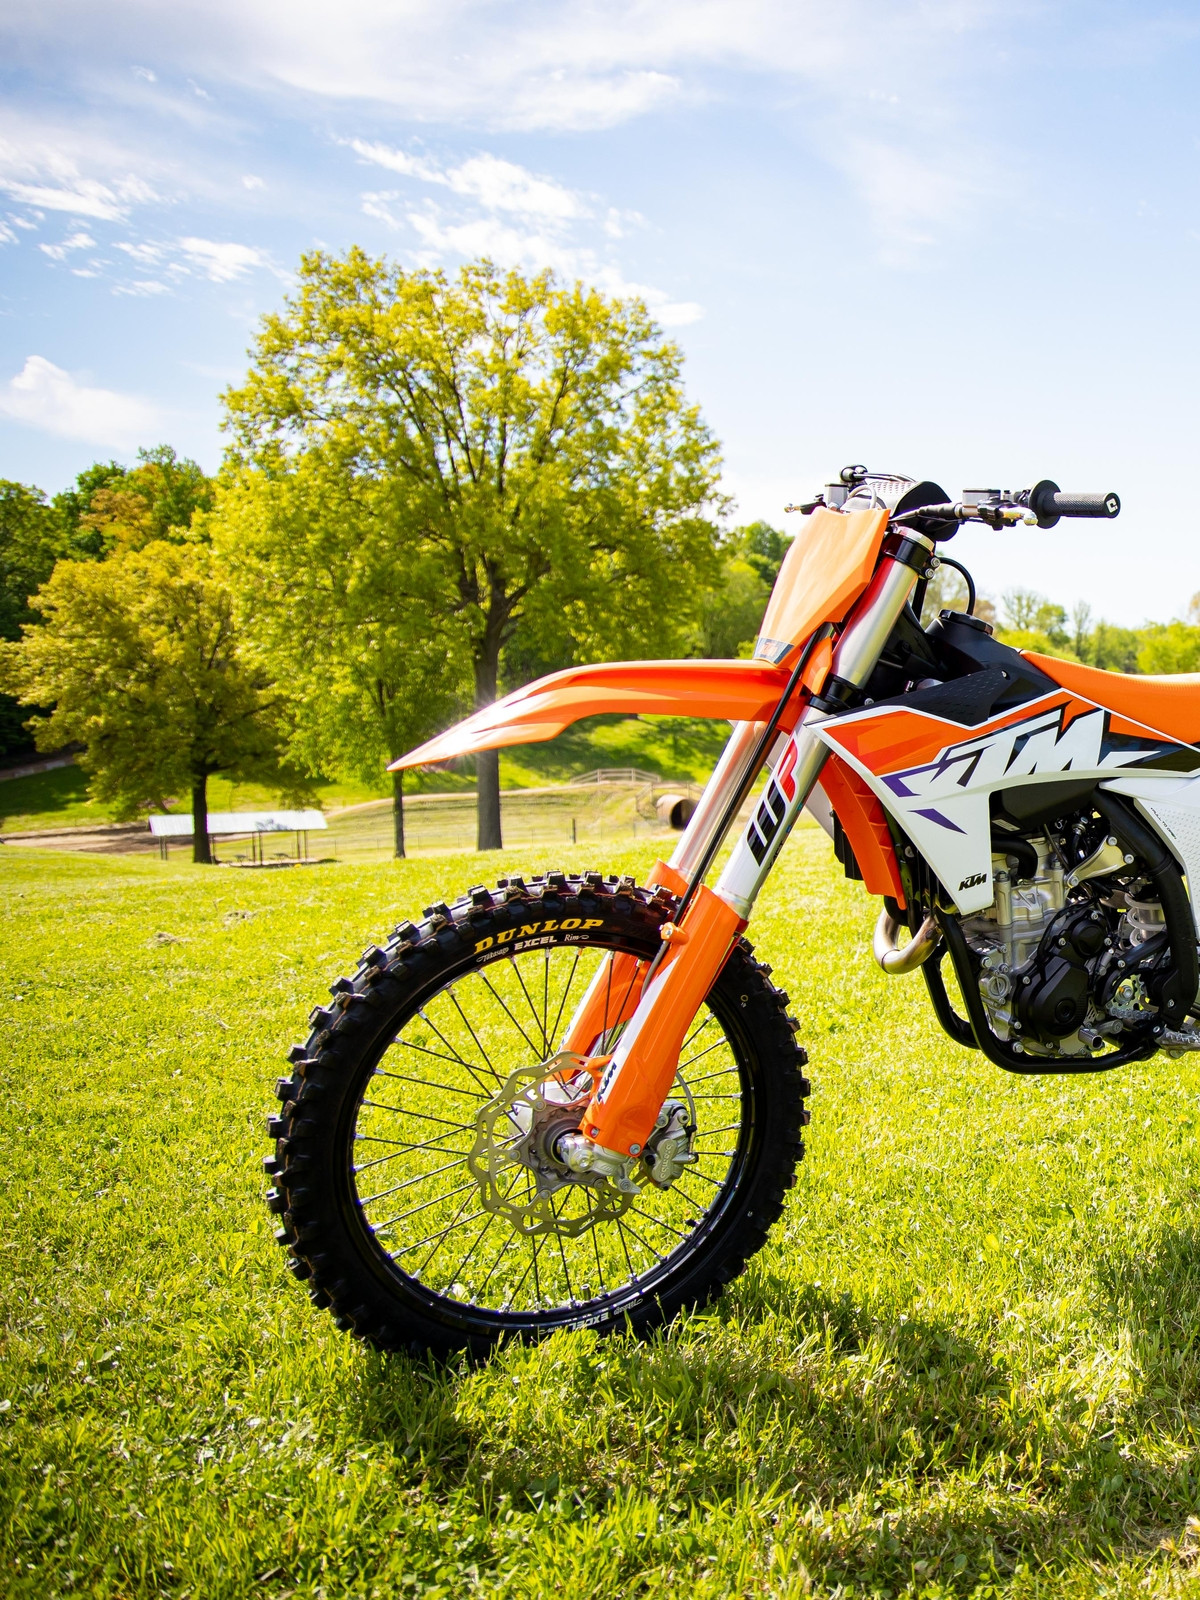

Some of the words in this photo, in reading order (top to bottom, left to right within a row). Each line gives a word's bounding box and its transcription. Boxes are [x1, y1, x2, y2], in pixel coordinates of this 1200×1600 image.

[898, 706, 1106, 788] KTM
[958, 873, 987, 891] KTM
[474, 918, 604, 955] DUNLOP
[514, 935, 557, 951] EXCEL
[564, 934, 582, 942] Rim
[568, 1311, 609, 1331] EXCEL
